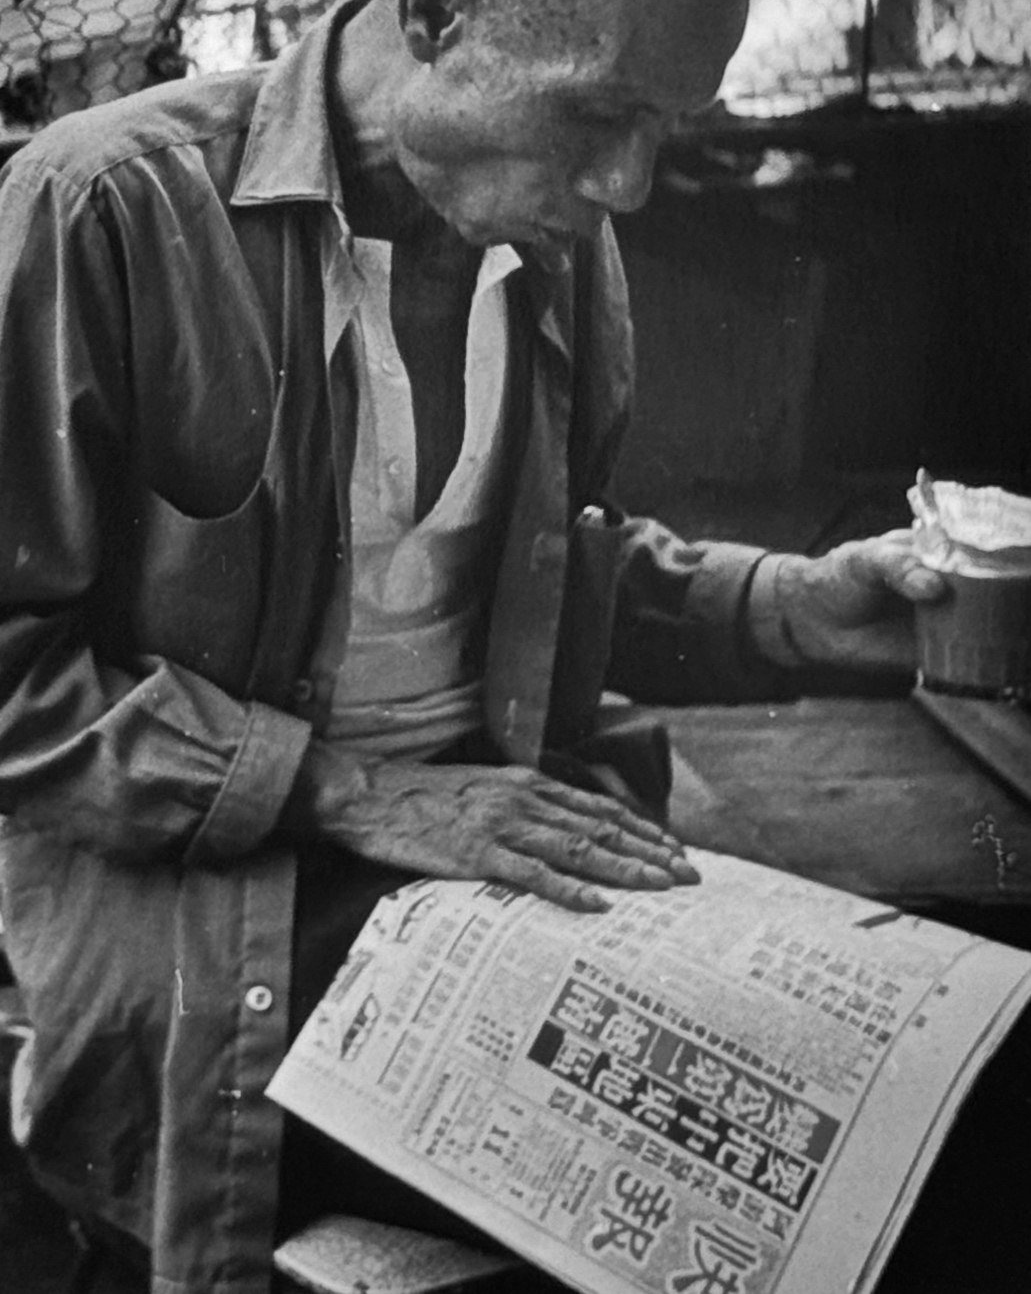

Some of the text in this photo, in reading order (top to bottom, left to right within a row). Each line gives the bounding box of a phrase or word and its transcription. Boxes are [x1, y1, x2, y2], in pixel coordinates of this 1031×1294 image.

[551, 1030, 811, 1204] 要把中東地區
[591, 1172, 756, 1294] 快報
